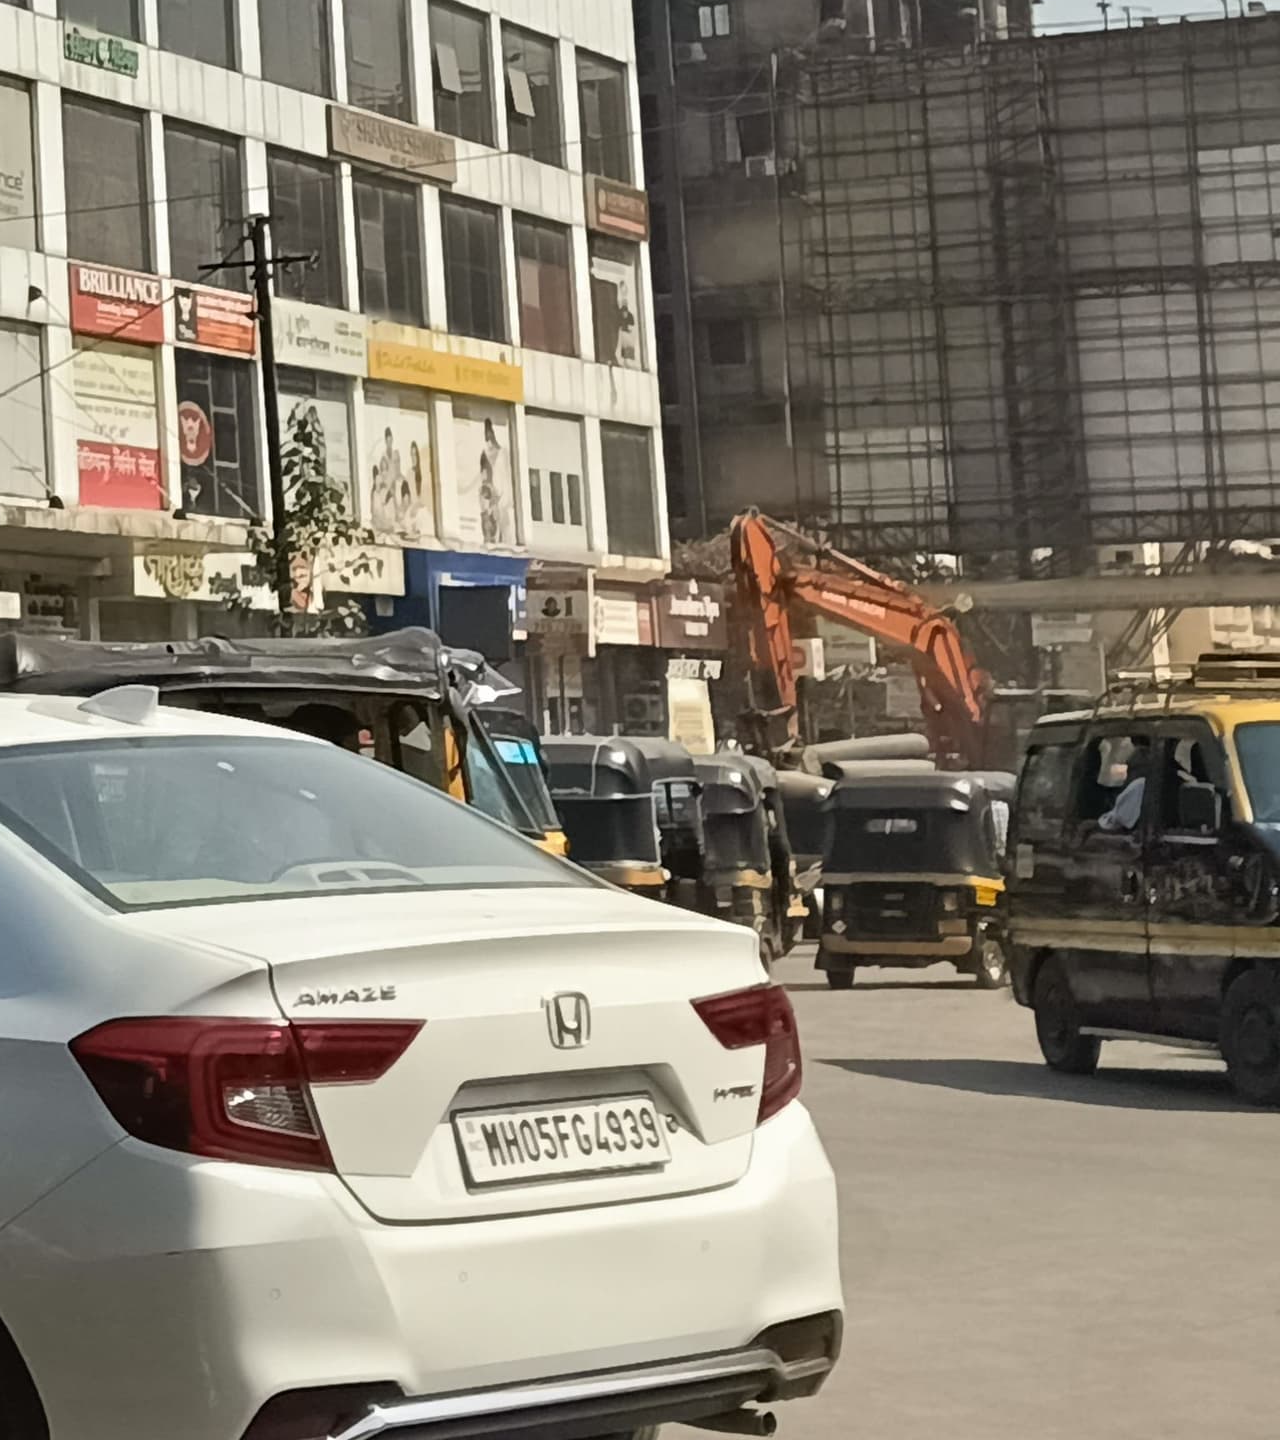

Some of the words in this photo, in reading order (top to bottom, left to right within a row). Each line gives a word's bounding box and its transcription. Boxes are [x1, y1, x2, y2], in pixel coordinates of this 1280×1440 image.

[78, 266, 162, 305] BRILLIANCE
[292, 985, 397, 1008] AMAZE
[480, 1107, 661, 1167] MH05FG4939
